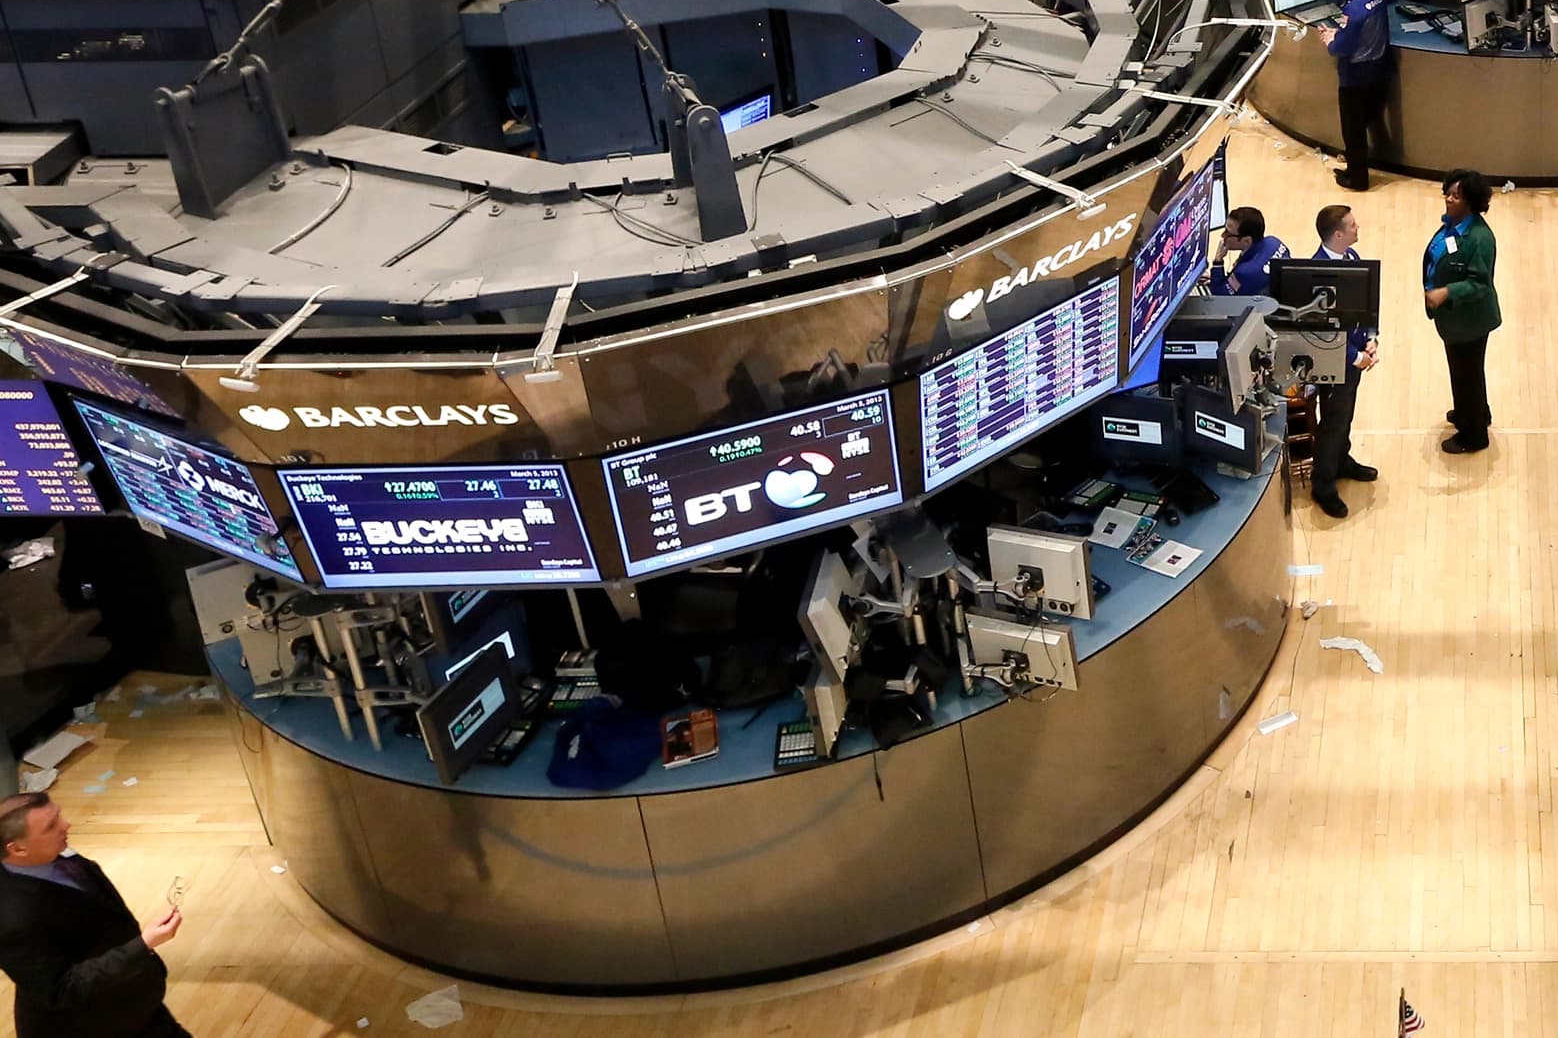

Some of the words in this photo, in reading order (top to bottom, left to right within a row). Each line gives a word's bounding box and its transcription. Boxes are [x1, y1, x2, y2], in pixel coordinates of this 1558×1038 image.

[986, 212, 1137, 304] BARCLAYS
[293, 403, 520, 428] BARCLAYS
[836, 401, 858, 412] March
[789, 420, 821, 437] 40.58
[850, 405, 881, 422] 40.59
[510, 470, 533, 478] March
[623, 465, 641, 481] BT
[205, 475, 266, 512] MERCK
[300, 483, 324, 496] BKI
[464, 480, 497, 492] 27.46
[526, 479, 560, 490] 27.48
[683, 481, 763, 527] BT
[361, 518, 529, 545] BUCKEYE
[371, 545, 493, 554] TECHNOLOGIES
